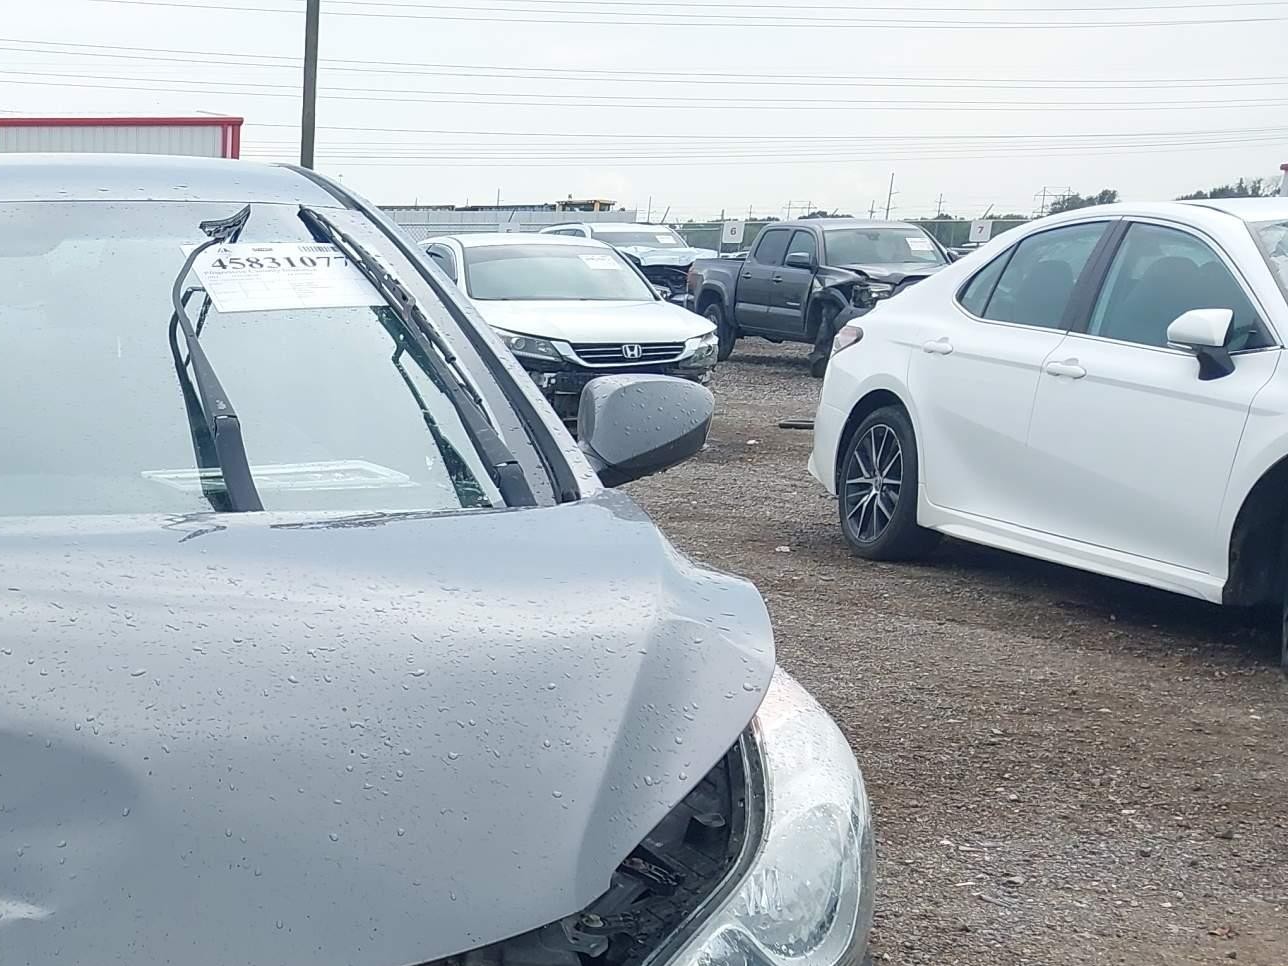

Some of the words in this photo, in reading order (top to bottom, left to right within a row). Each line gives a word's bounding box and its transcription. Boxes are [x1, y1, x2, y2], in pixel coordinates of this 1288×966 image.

[730, 227, 737, 235] 6
[977, 226, 985, 234] 7
[211, 255, 350, 270] 45831077
